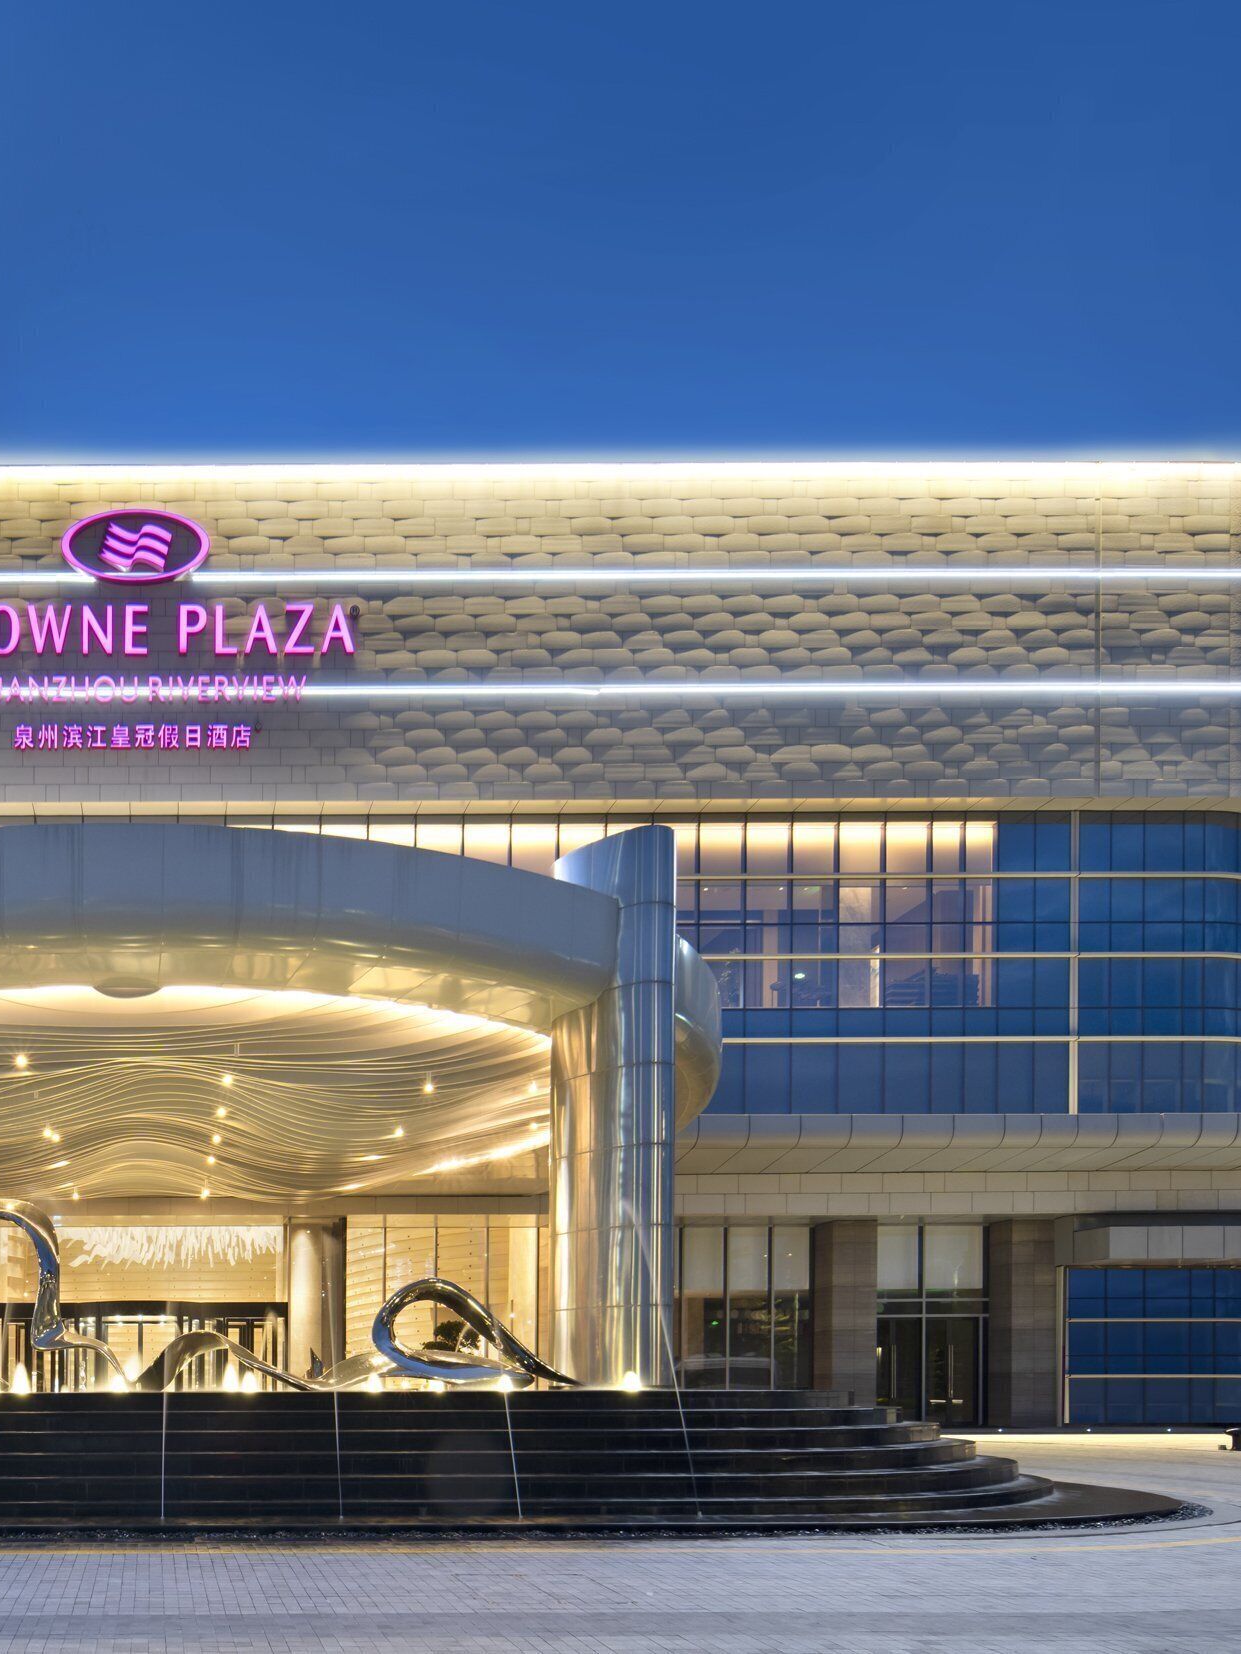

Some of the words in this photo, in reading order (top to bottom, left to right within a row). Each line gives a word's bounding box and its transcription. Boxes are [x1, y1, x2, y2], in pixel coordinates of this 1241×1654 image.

[178, 604, 355, 655] PLAZA
[148, 675, 307, 704] RIVERVIEW
[13, 723, 252, 750] 泉州滨江皇冠假日酒店
